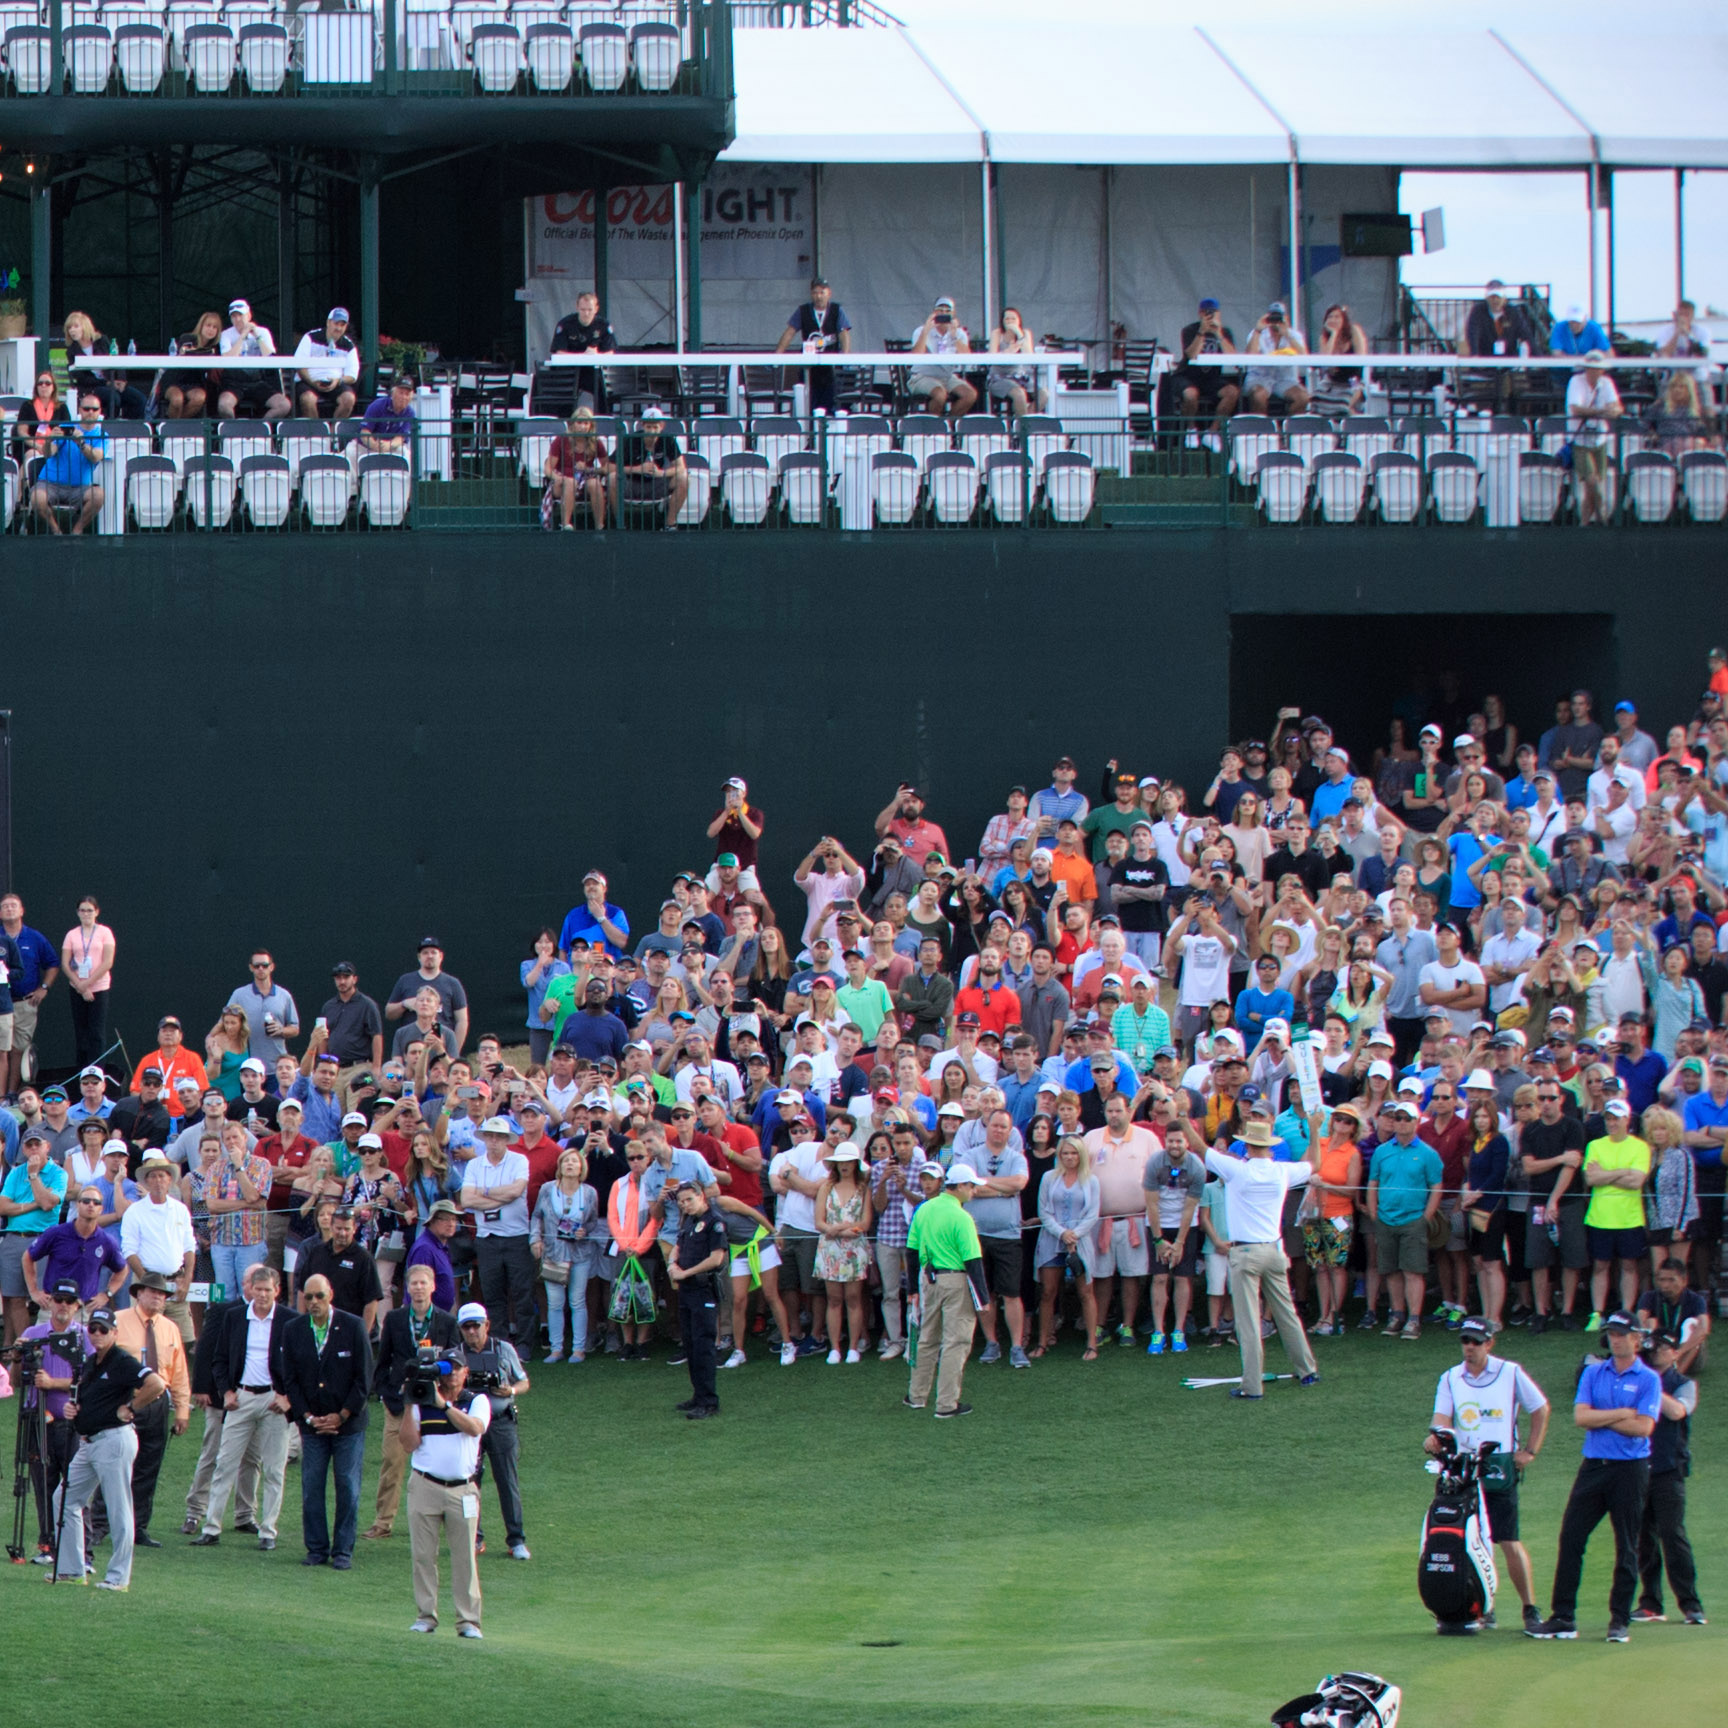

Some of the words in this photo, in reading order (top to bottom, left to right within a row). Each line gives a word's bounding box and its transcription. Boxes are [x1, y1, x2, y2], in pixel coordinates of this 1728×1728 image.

[686, 187, 798, 224] IGHT
[544, 227, 579, 240] Official
[618, 227, 637, 240] The
[638, 227, 668, 240] Waste
[736, 227, 777, 240] Phoenix
[778, 227, 804, 242] Open
